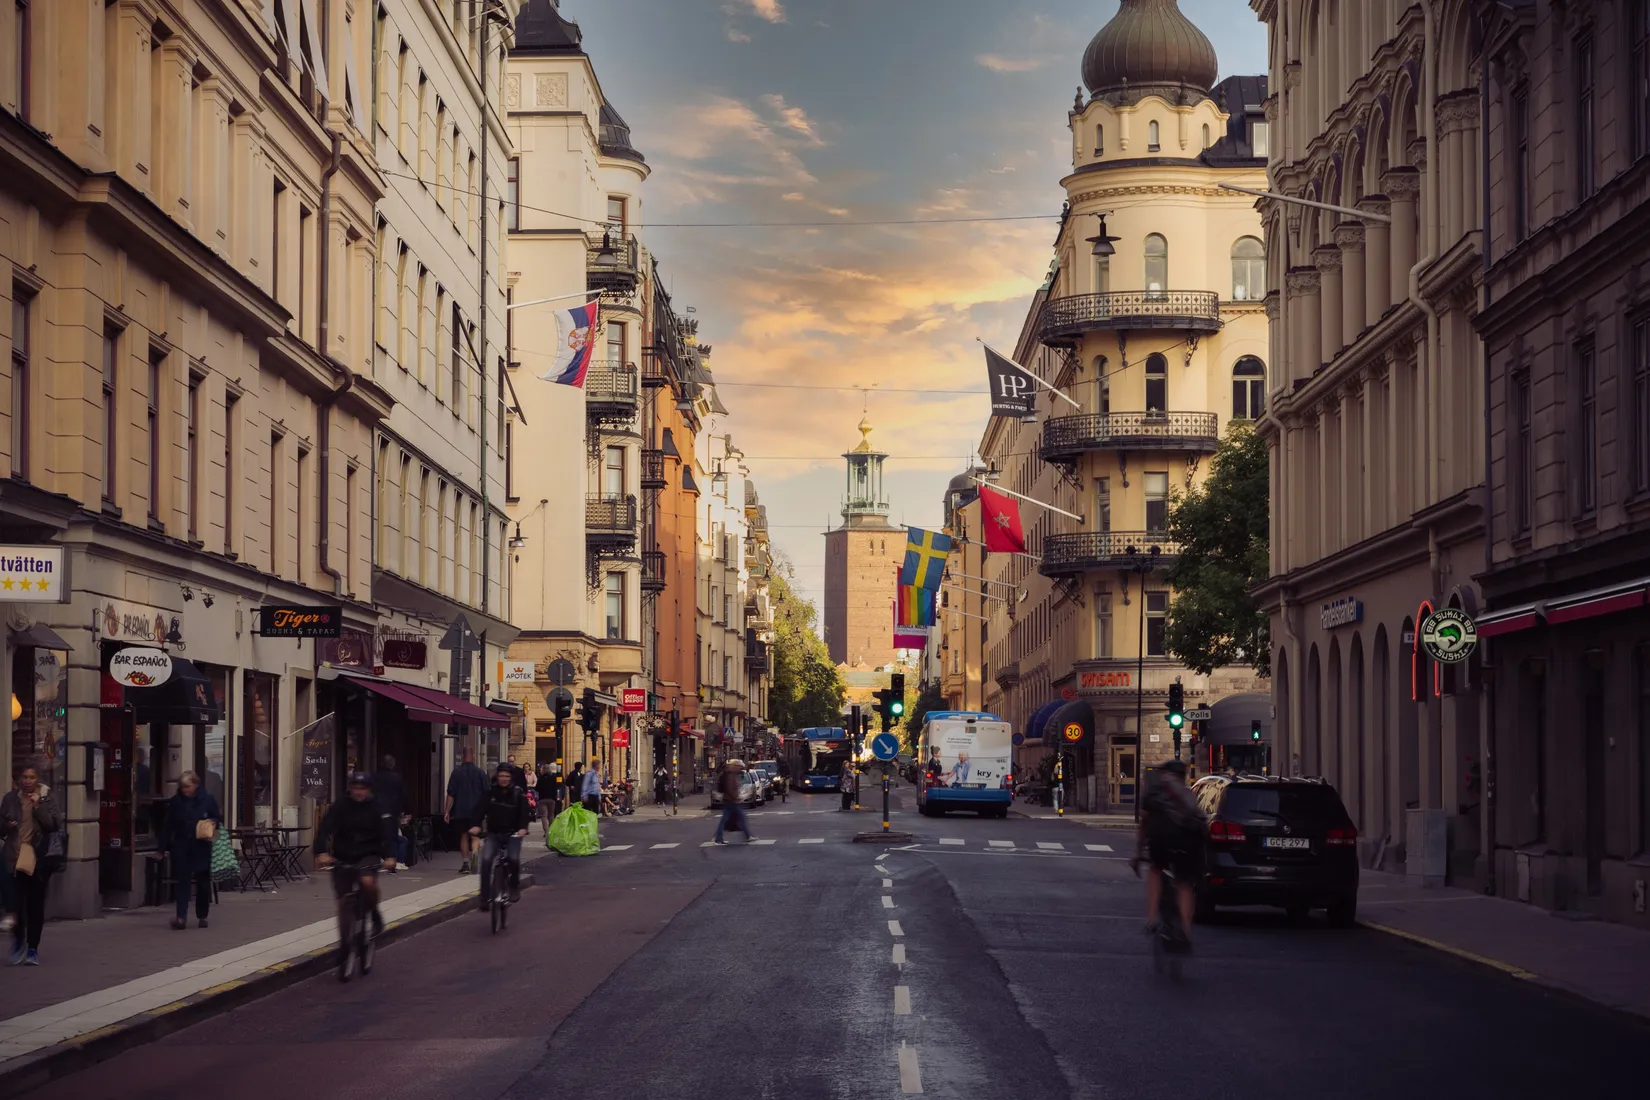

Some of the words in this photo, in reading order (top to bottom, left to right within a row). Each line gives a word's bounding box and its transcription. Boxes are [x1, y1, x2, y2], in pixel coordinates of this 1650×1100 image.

[1, 556, 53, 573] tvätten
[274, 609, 320, 628] Tiger
[297, 627, 304, 635] &
[114, 655, 132, 666] BAR
[133, 655, 168, 668] ESPAÑOL
[1067, 727, 1080, 737] 30
[312, 767, 319, 775] &
[977, 770, 992, 778] kry
[306, 778, 323, 786] Wok
[1270, 838, 1286, 847] GCE
[1289, 838, 1306, 847] 297
